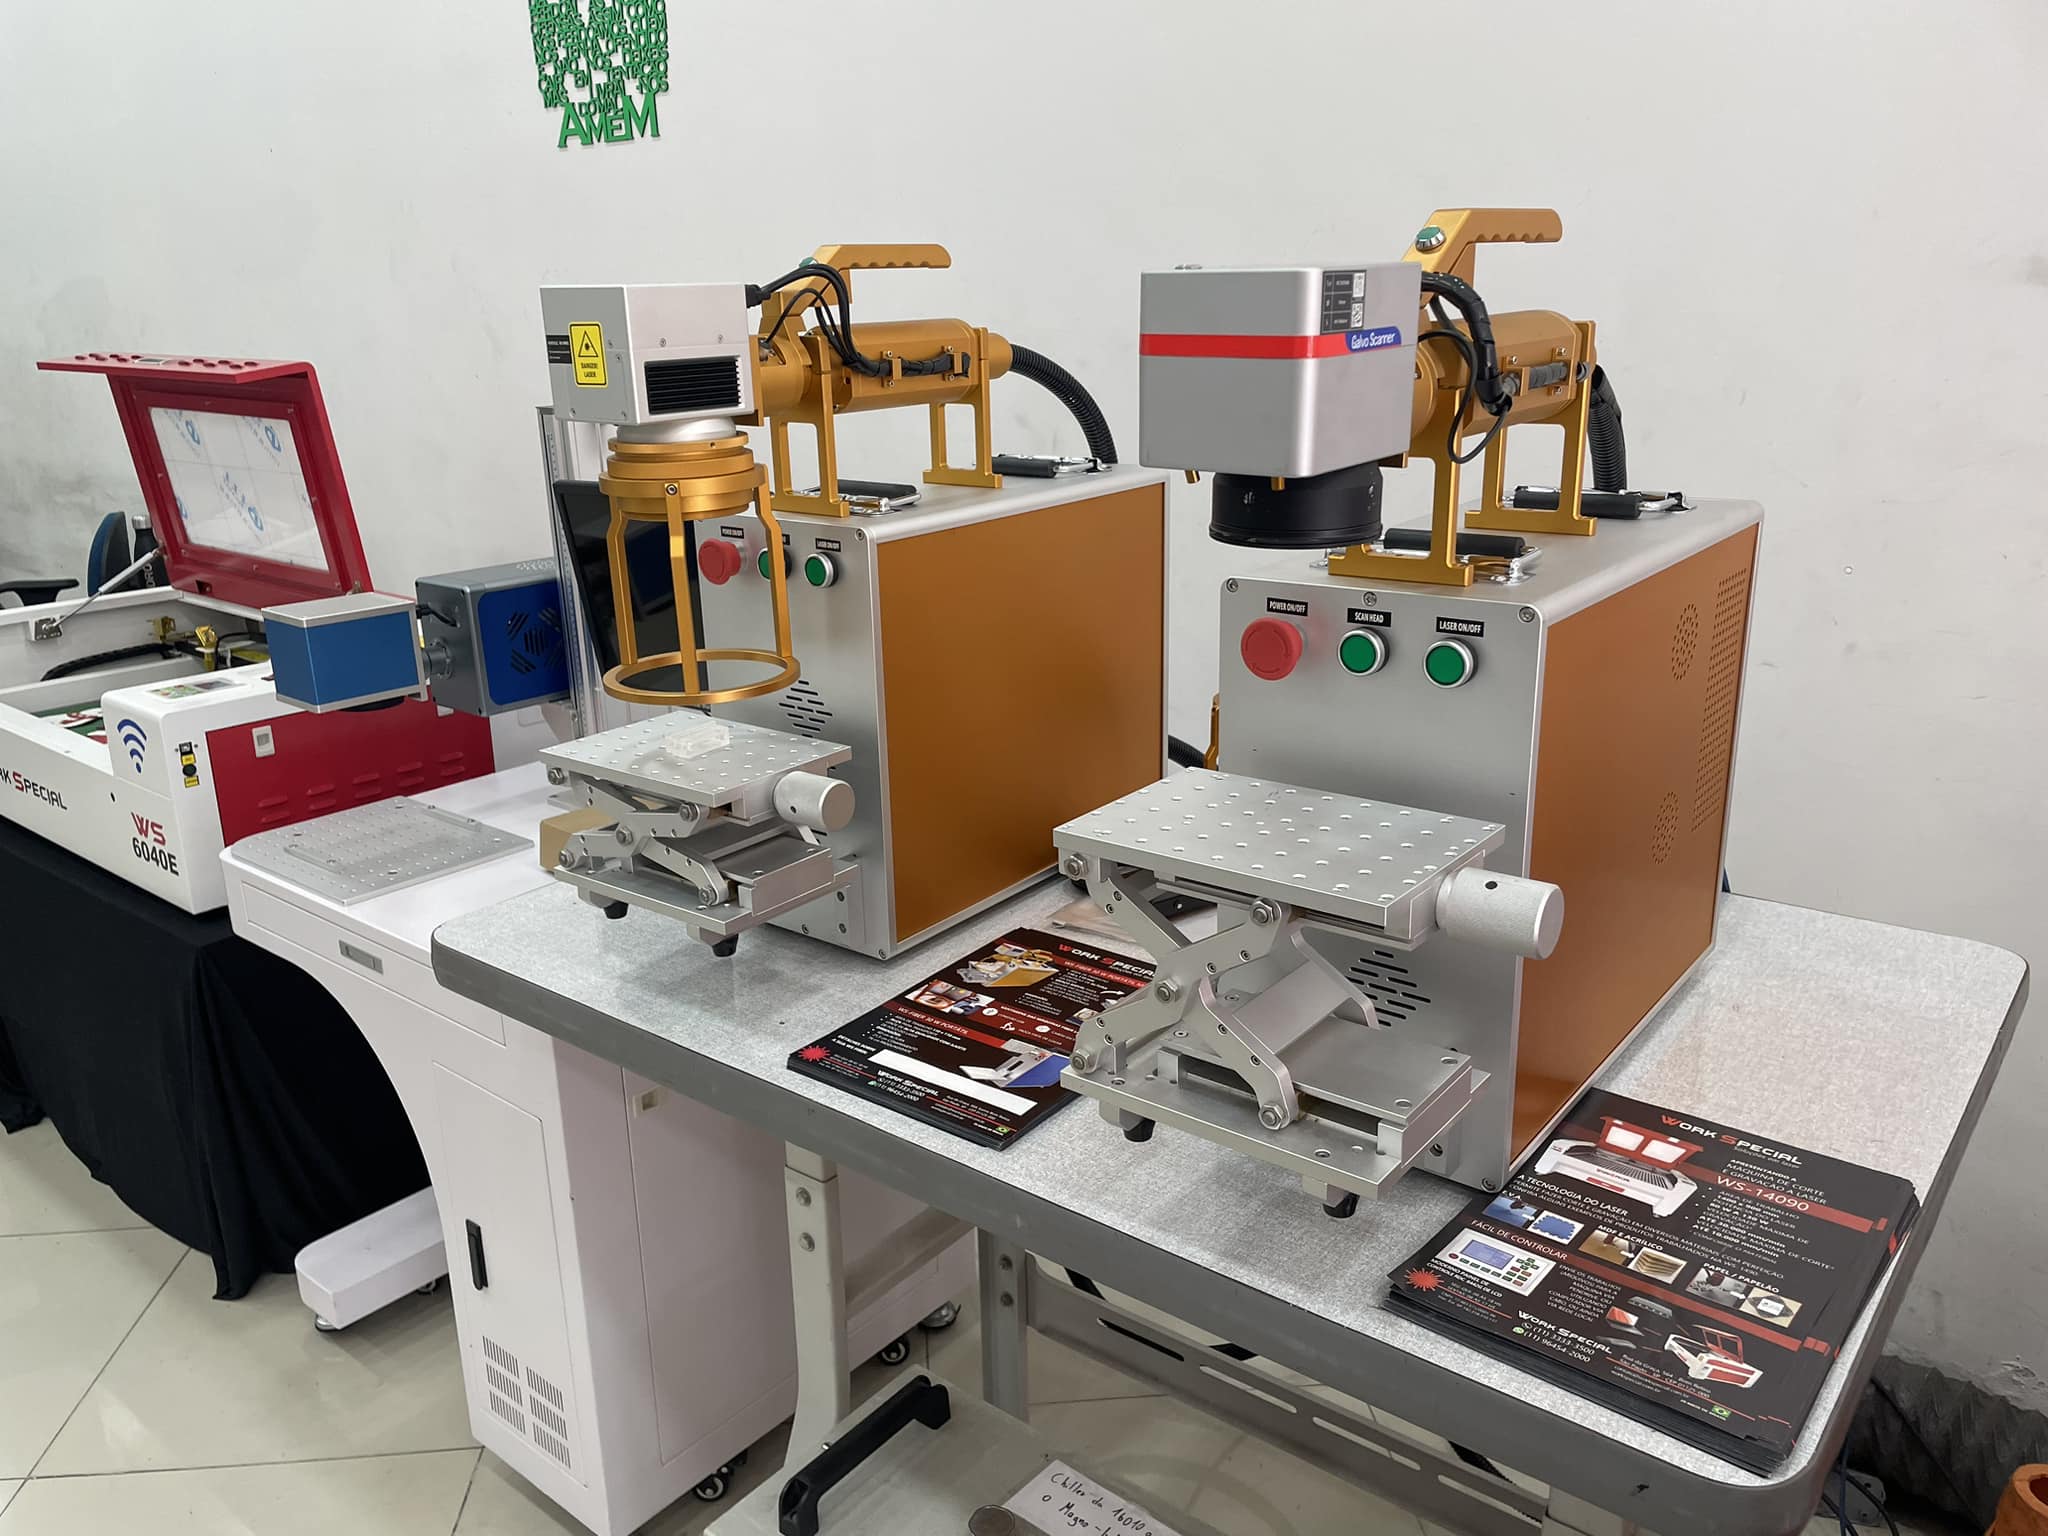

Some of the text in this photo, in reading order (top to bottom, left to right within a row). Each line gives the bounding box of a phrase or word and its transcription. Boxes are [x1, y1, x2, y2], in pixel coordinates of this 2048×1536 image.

[1269, 600, 1306, 614] POWER ON/OFF
[1354, 611, 1384, 623] SCAN HEAD
[1439, 620, 1482, 634] LASER ON/OFF
[12, 771, 68, 811] SPECIAL
[131, 812, 166, 846] WS
[132, 837, 180, 876] 6040E
[1059, 944, 1100, 960] WORK
[1102, 957, 1155, 977] SPECIA
[1662, 1115, 1801, 1164] WORK SPECIAL
[1527, 1177, 1581, 1200] TECNOLOGIA
[1583, 1197, 1599, 1205] DO
[1599, 1202, 1628, 1216] LASER
[1718, 1176, 1809, 1210] WS-14090
[1792, 1184, 1824, 1196] CORTE
[1796, 1192, 1826, 1204] LASER
[1496, 1229, 1510, 1238] DE
[1511, 1235, 1567, 1259] CONTROLAR
[1598, 1225, 1617, 1234] MDF
[1703, 1263, 1729, 1275] PAPEL
[1738, 1275, 1779, 1293] PAPELÃO
[1518, 1310, 1612, 1354] WORK SPECIAL
